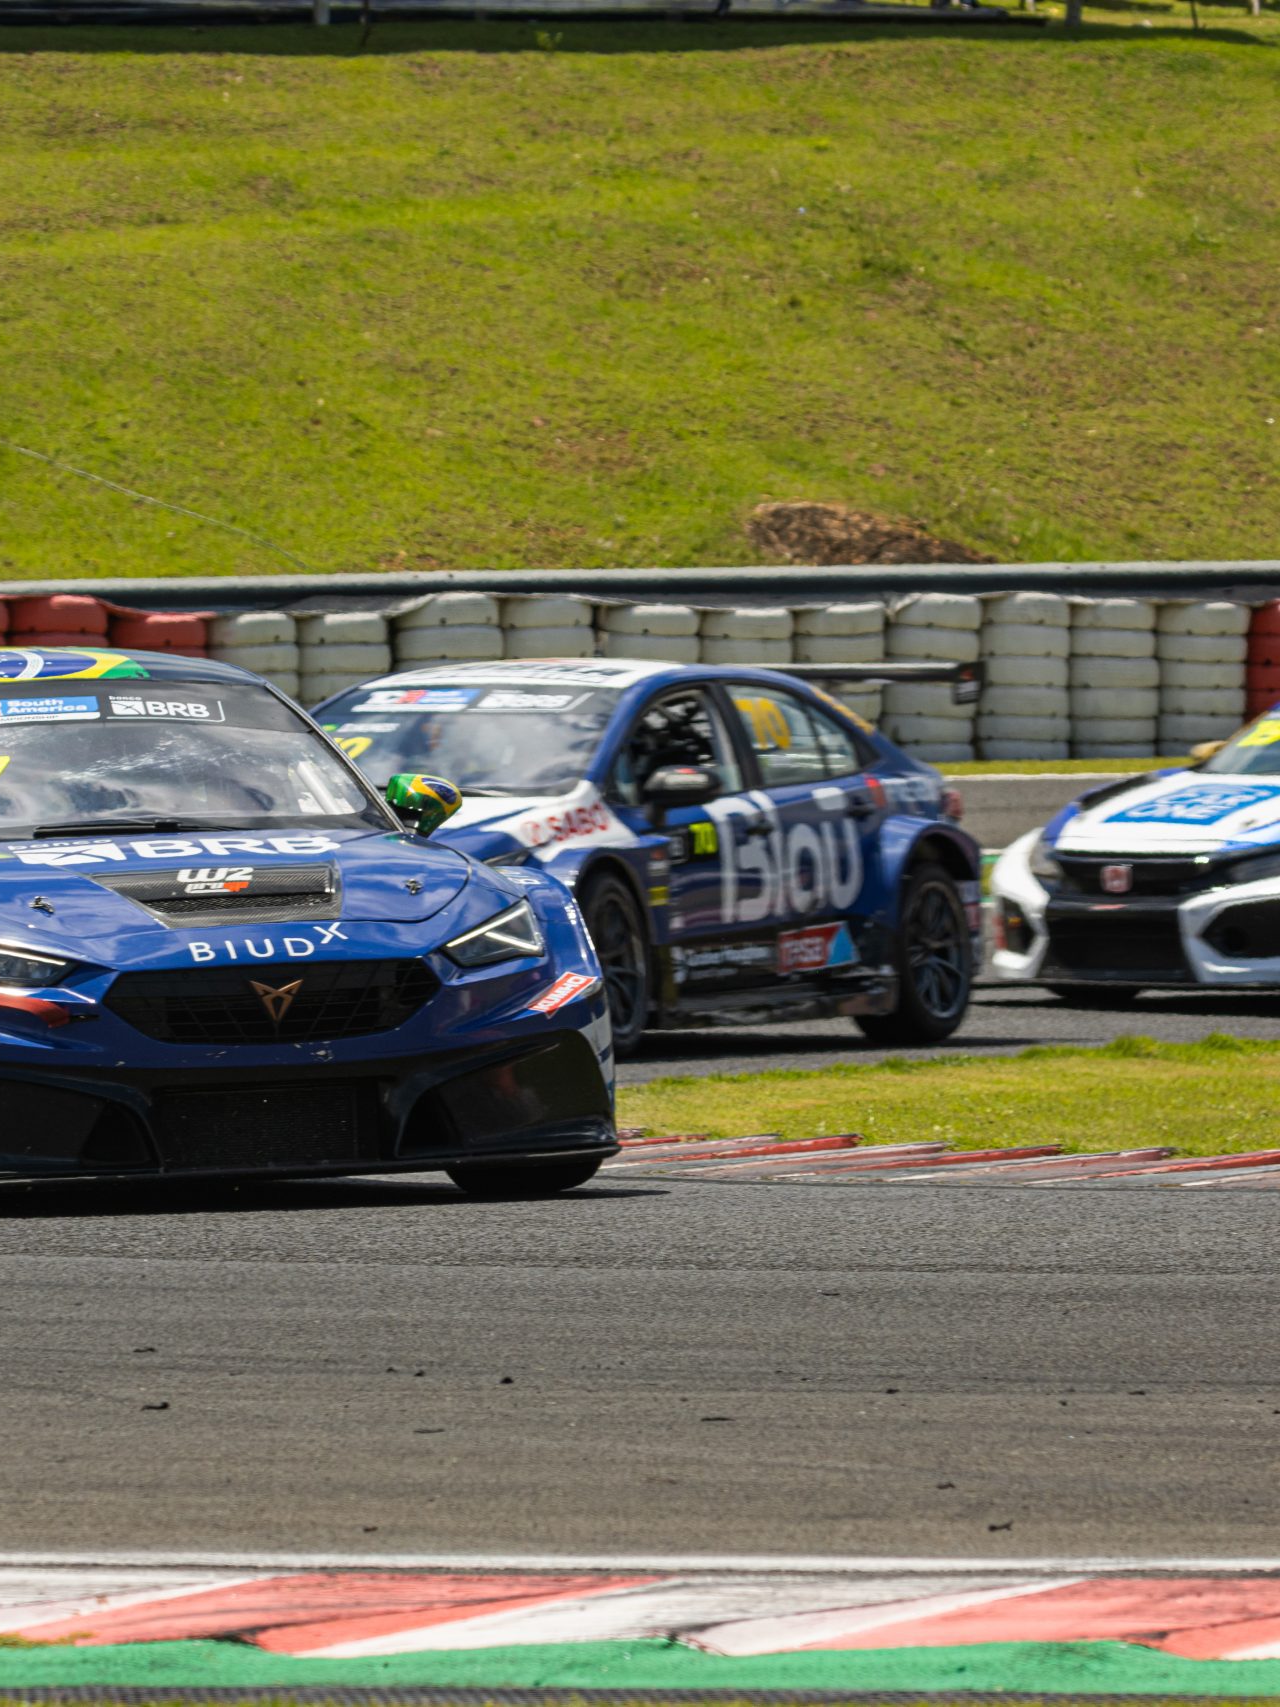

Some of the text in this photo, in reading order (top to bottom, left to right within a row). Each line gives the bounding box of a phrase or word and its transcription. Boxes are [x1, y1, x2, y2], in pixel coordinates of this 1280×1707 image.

[7, 698, 64, 708] South
[7, 704, 88, 714] America
[145, 701, 210, 718] BRB
[733, 697, 792, 749] 70
[8, 839, 112, 850] banco
[129, 836, 342, 859] BRB
[176, 867, 254, 883] W2
[188, 922, 349, 962] BIUDX
[534, 976, 588, 1012] KUMHO
